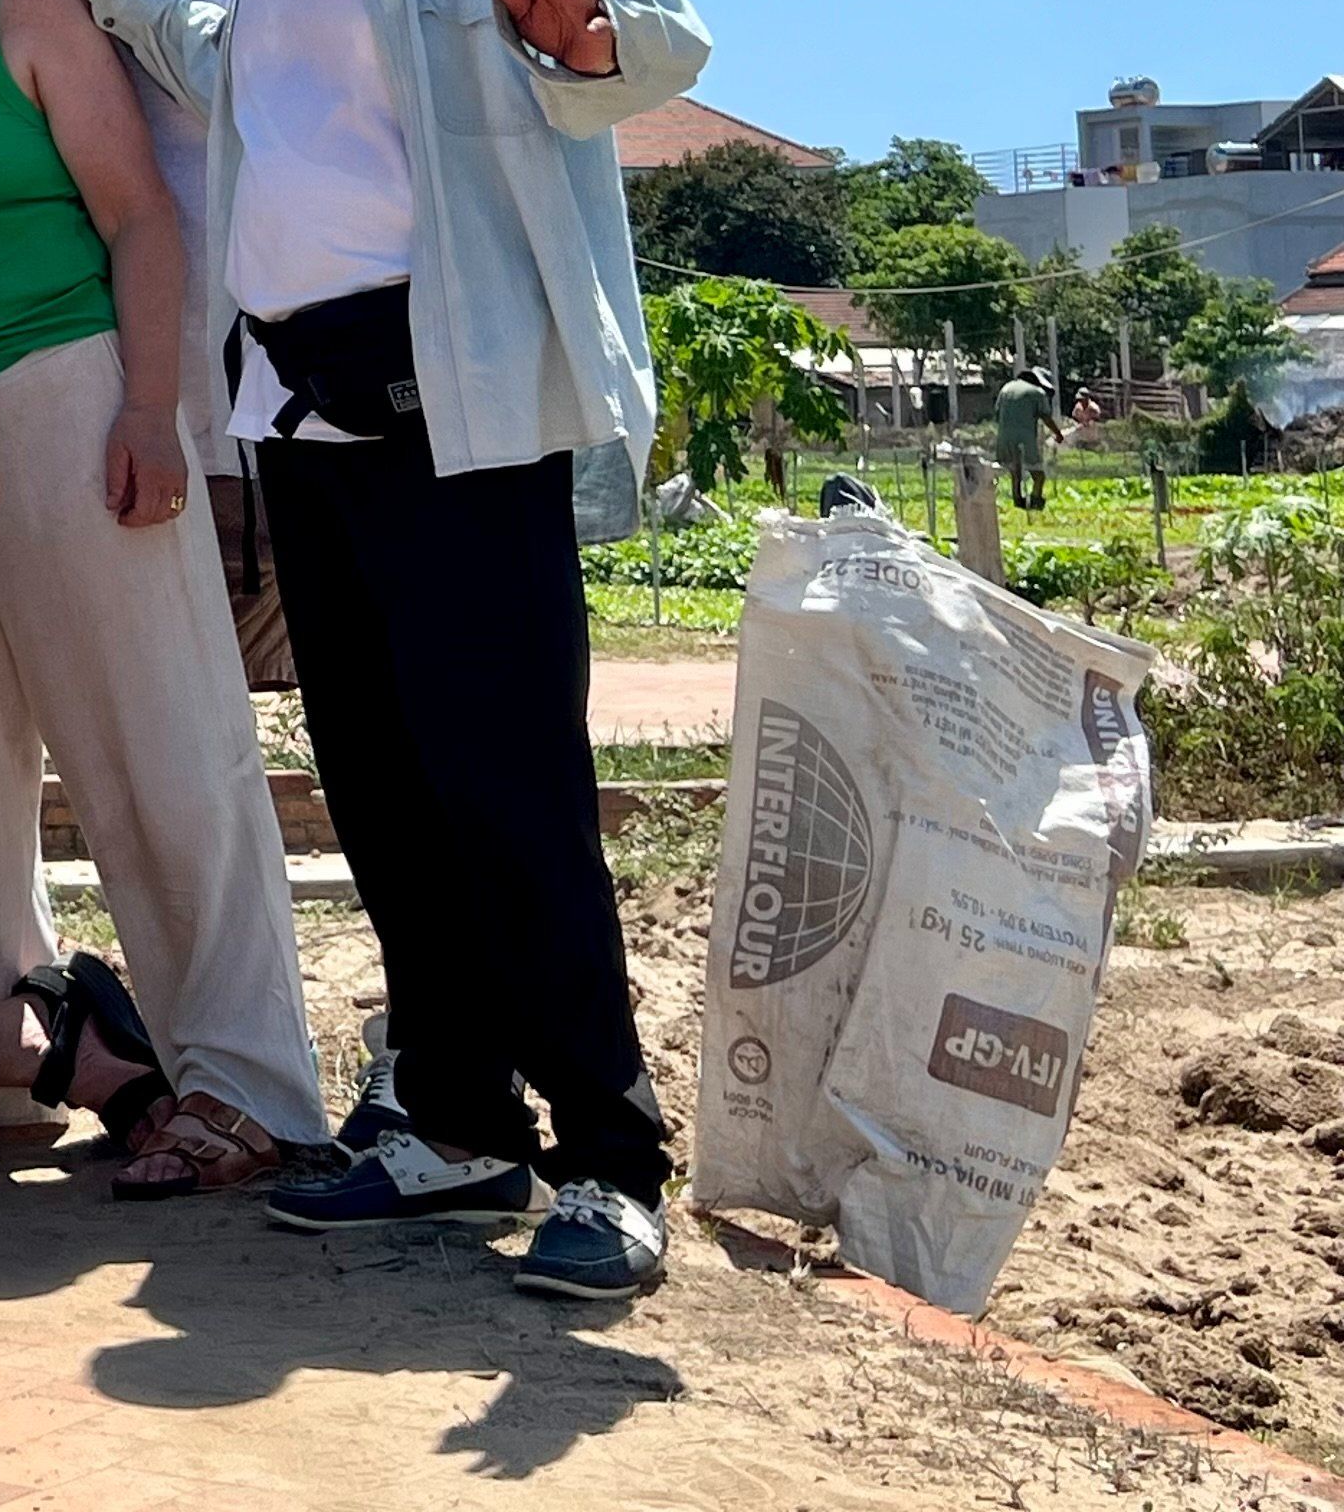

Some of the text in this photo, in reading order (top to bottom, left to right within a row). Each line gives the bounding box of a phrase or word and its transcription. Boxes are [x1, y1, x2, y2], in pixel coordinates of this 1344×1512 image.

[732, 716, 801, 981] INTERFLOUR
[920, 906, 953, 942] kg
[959, 924, 986, 953] 25
[944, 1027, 1062, 1089] IFV-GP
[964, 1142, 1013, 1168] FLOUR
